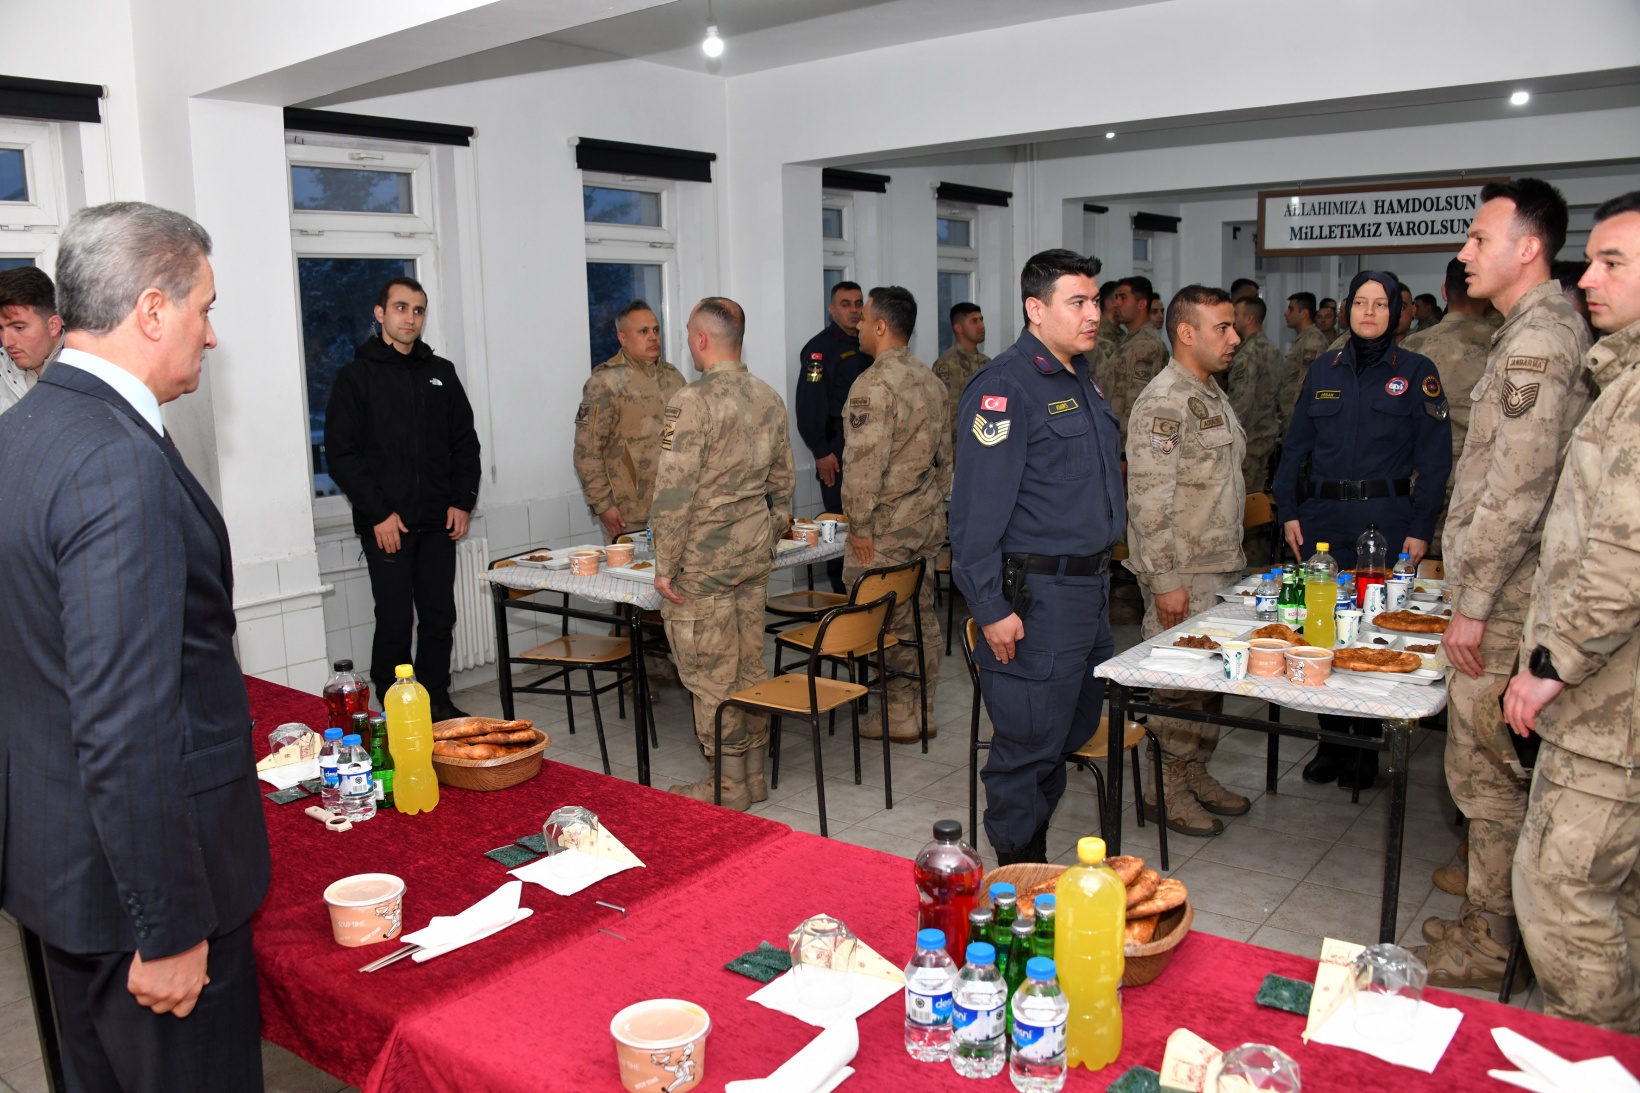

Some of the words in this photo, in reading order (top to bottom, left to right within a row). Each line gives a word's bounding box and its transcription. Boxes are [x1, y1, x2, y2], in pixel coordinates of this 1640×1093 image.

[1284, 200, 1366, 217] ALLAHIMIZA
[1374, 194, 1477, 214] HAMDOLSUN
[1290, 222, 1382, 241] MiLLETiMiZ
[1386, 218, 1474, 236] VAROLSUN
[1510, 359, 1542, 369] JANDARMA
